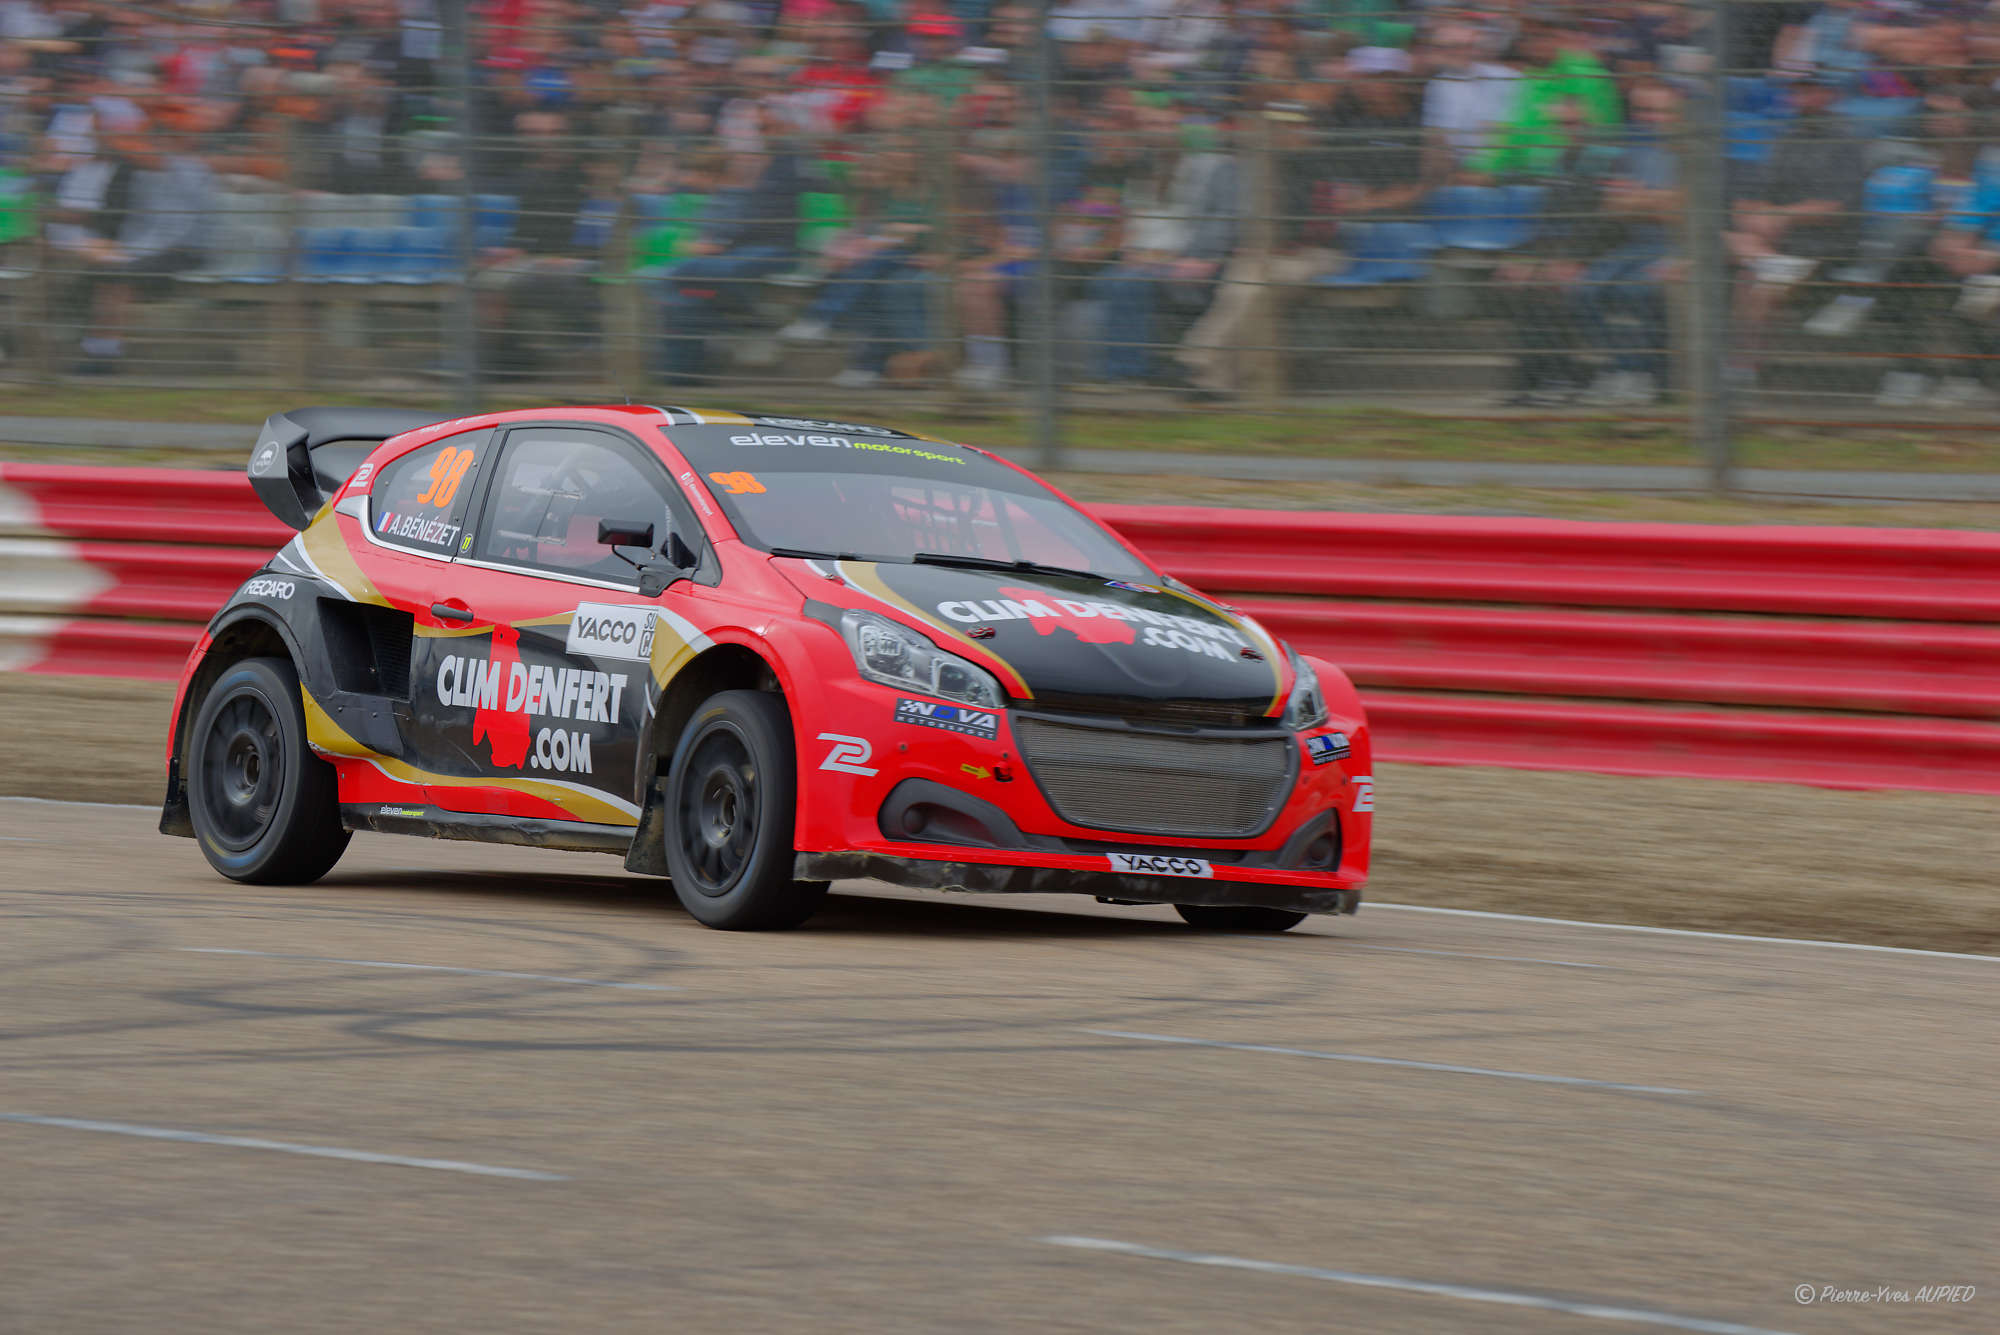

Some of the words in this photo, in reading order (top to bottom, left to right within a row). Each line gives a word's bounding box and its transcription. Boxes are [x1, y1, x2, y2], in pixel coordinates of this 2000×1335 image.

[730, 432, 852, 448] eleven
[853, 441, 966, 465] motorsport
[416, 446, 475, 508] 98
[708, 471, 767, 494] 98
[388, 512, 460, 547] A.BÉNÉZET
[243, 580, 296, 600] RECARO
[577, 616, 637, 645] YACCO
[936, 598, 1062, 623] CLIM
[1053, 598, 1249, 648] DENFERT
[1142, 626, 1238, 663] .COM
[437, 655, 502, 707] CLIM
[506, 662, 628, 724] DENFERT
[530, 727, 593, 774] .COM
[1118, 855, 1202, 875] YACCO
